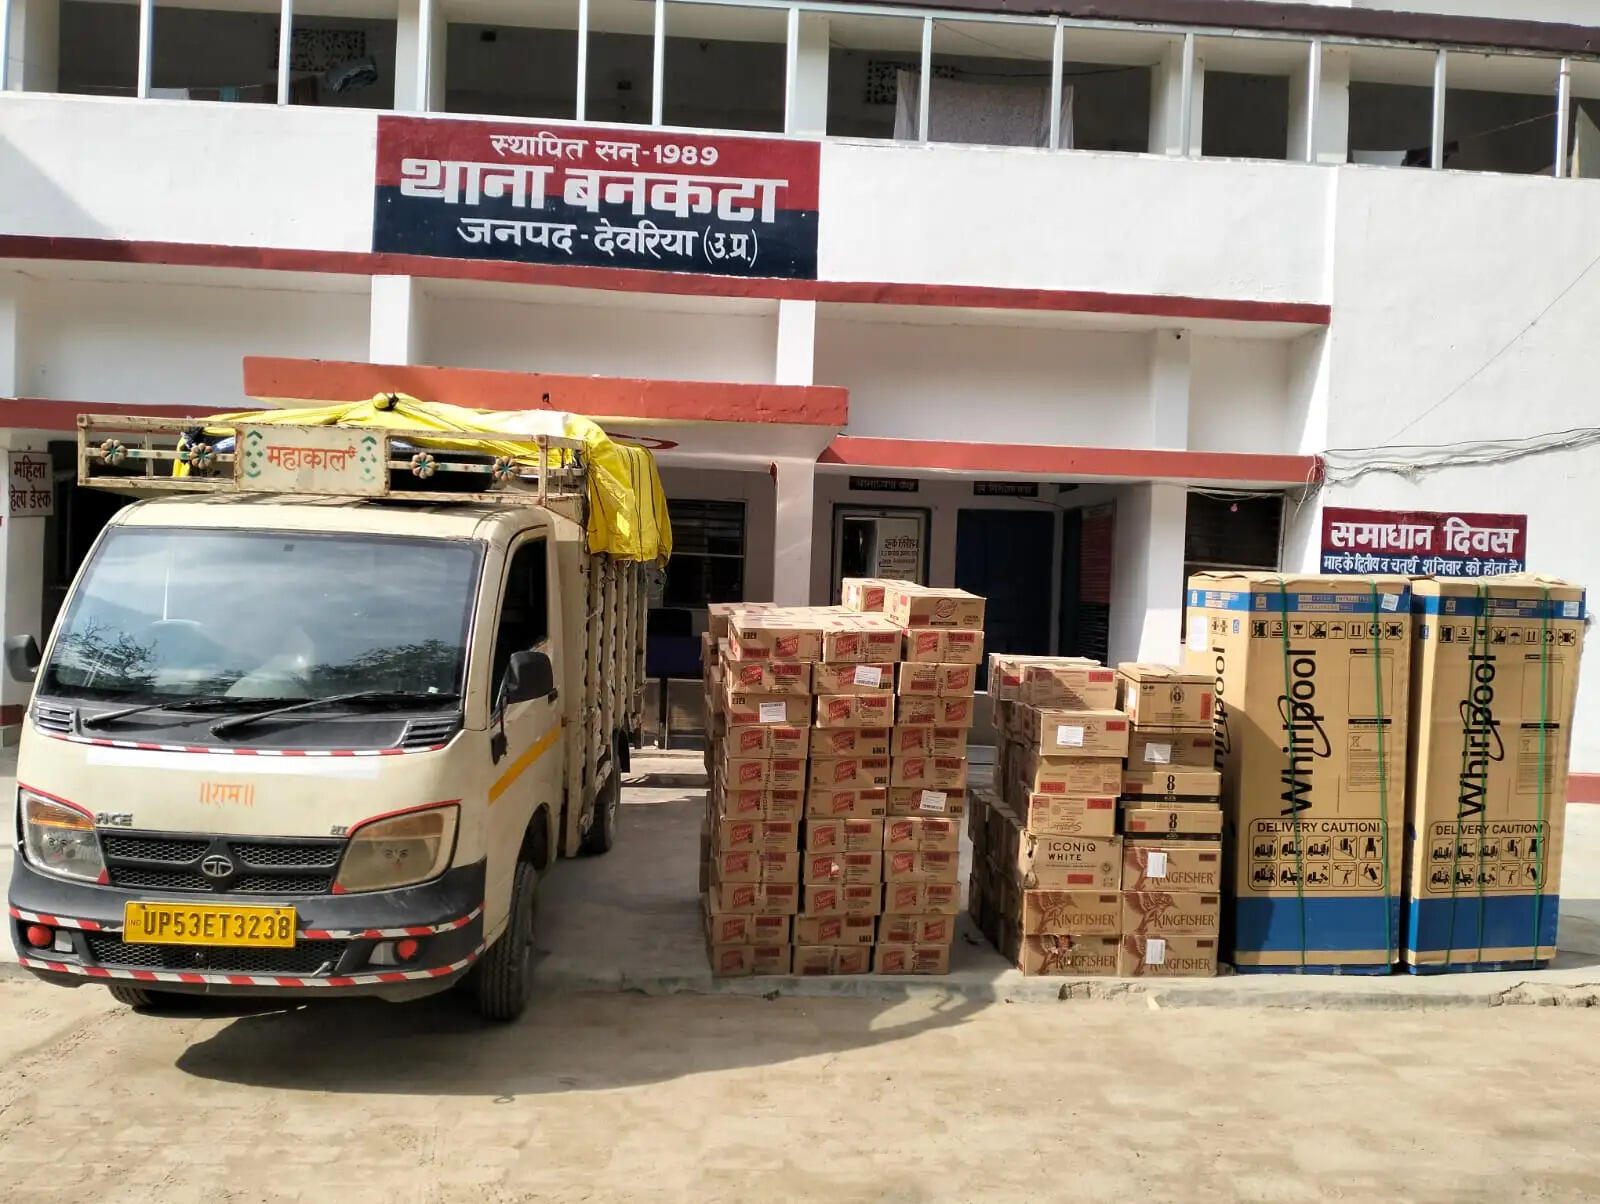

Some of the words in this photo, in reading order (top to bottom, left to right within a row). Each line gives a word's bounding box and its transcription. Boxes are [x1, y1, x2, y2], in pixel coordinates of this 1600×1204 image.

[489, 131, 588, 160] स्थापित
[400, 157, 554, 209] थाना
[563, 167, 789, 224] बनकटा
[456, 217, 577, 255] जनपद
[593, 218, 699, 259] देवरिया
[14, 455, 48, 481] महिला
[29, 485, 51, 509] डेस्क
[1330, 521, 1434, 550] समाधान
[1443, 516, 1519, 555] दिवस
[1323, 555, 1343, 573] माह
[1380, 558, 1388, 571] व
[1390, 555, 1420, 574] चतुर्थ
[1422, 556, 1463, 575] शनिवार
[1465, 557, 1482, 575] को
[1278, 648, 1331, 816] Whirlpool
[1457, 654, 1505, 818] Whirlpool
[1257, 822, 1317, 833] DELIVERY
[1436, 825, 1490, 835] DELVERY
[143, 910, 291, 940] UP53ET3238
[1053, 911, 1116, 928] KINGFISHER
[1154, 912, 1215, 928] KINGFISHER
